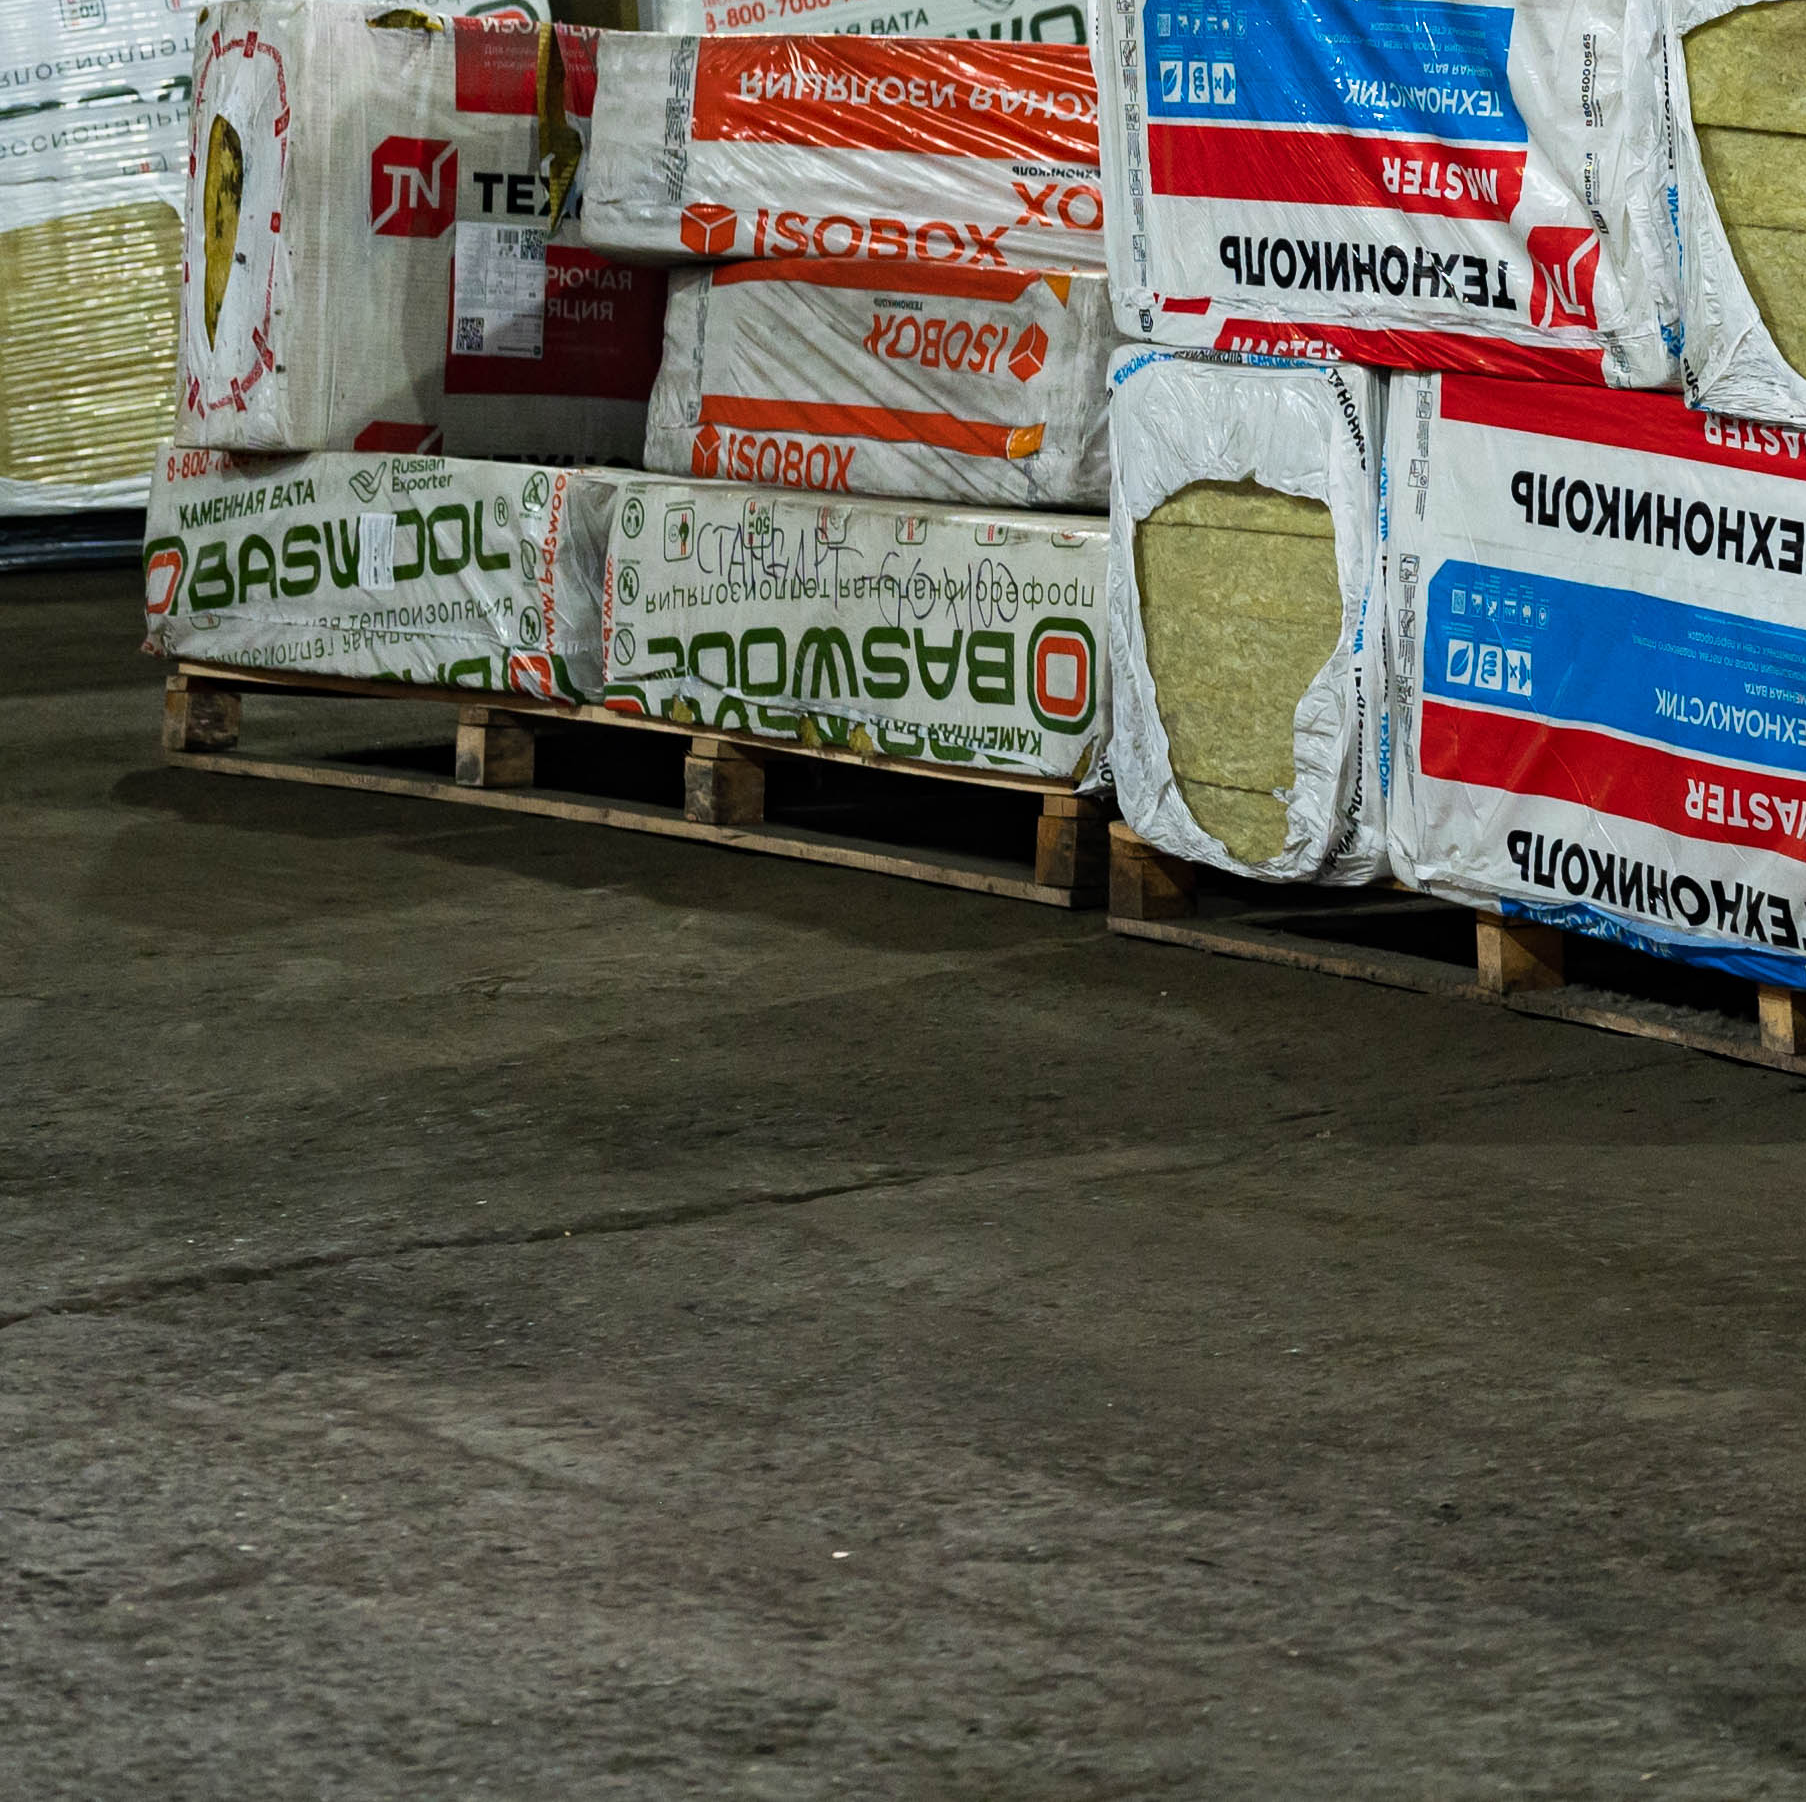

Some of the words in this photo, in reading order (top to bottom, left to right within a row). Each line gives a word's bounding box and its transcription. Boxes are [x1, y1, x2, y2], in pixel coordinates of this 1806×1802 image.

[869, 8, 930, 37] ВАТА
[738, 69, 957, 111] ИЗОЛЯЦИЯ
[1011, 165, 1102, 181] ЕХНОНИКОЛЬ
[1381, 156, 1499, 205] MASTER
[753, 208, 1009, 267] ISOBOX
[1220, 234, 1519, 312] ТЕХНОНИКОЛЬ
[861, 313, 1009, 374] ISOBOX
[391, 457, 446, 474] Russian
[726, 433, 857, 492] ISOBOX
[178, 488, 268, 532] КАМЕННАЯ
[269, 478, 316, 510] ВАТА
[391, 473, 454, 495] Exporter
[645, 576, 831, 614] теплоизоляция
[1743, 682, 1768, 698] ВАТА
